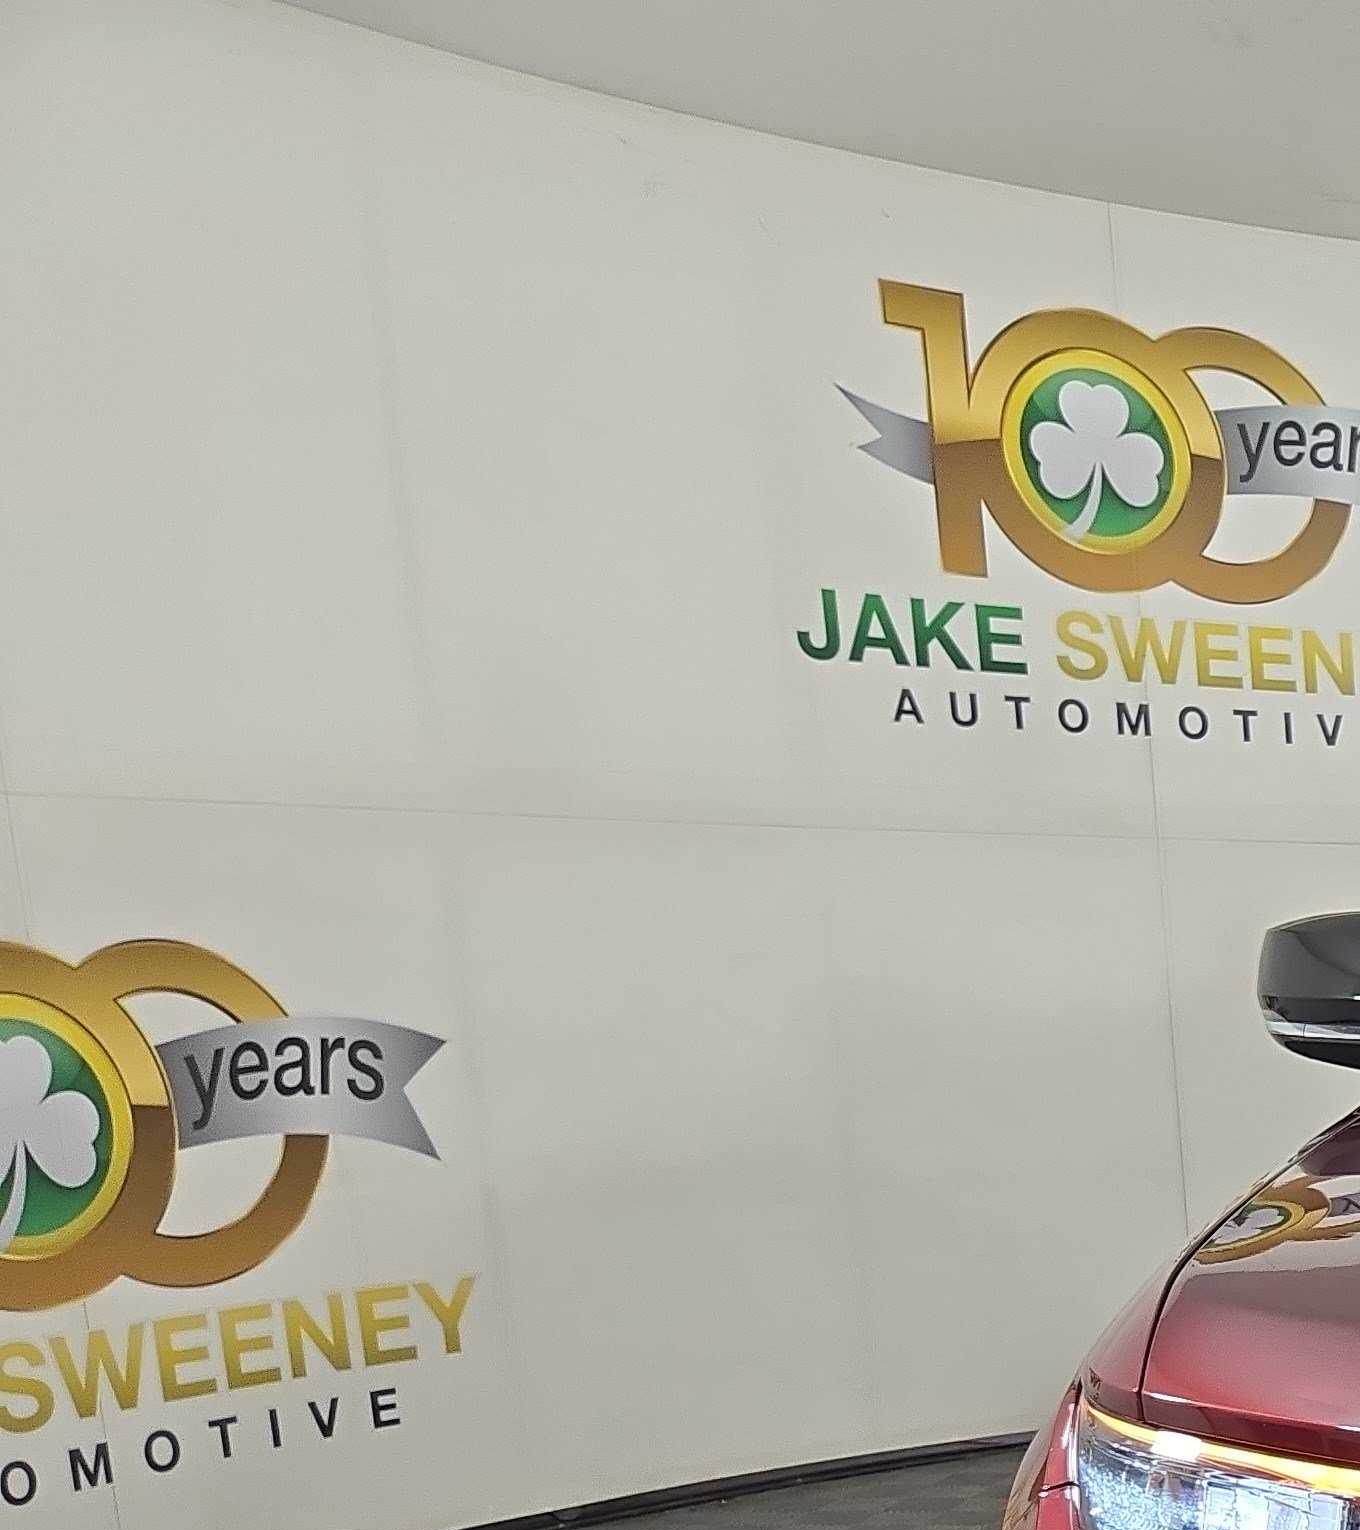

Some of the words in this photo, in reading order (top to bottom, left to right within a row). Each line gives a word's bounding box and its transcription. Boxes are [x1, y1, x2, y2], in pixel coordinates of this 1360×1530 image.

[877, 278, 1352, 604] 100
[797, 588, 1028, 675] JAKE
[183, 1035, 385, 1130] years
[0, 1277, 477, 1433] SWEENEY
[0, 1388, 400, 1506] OMOTIVE
